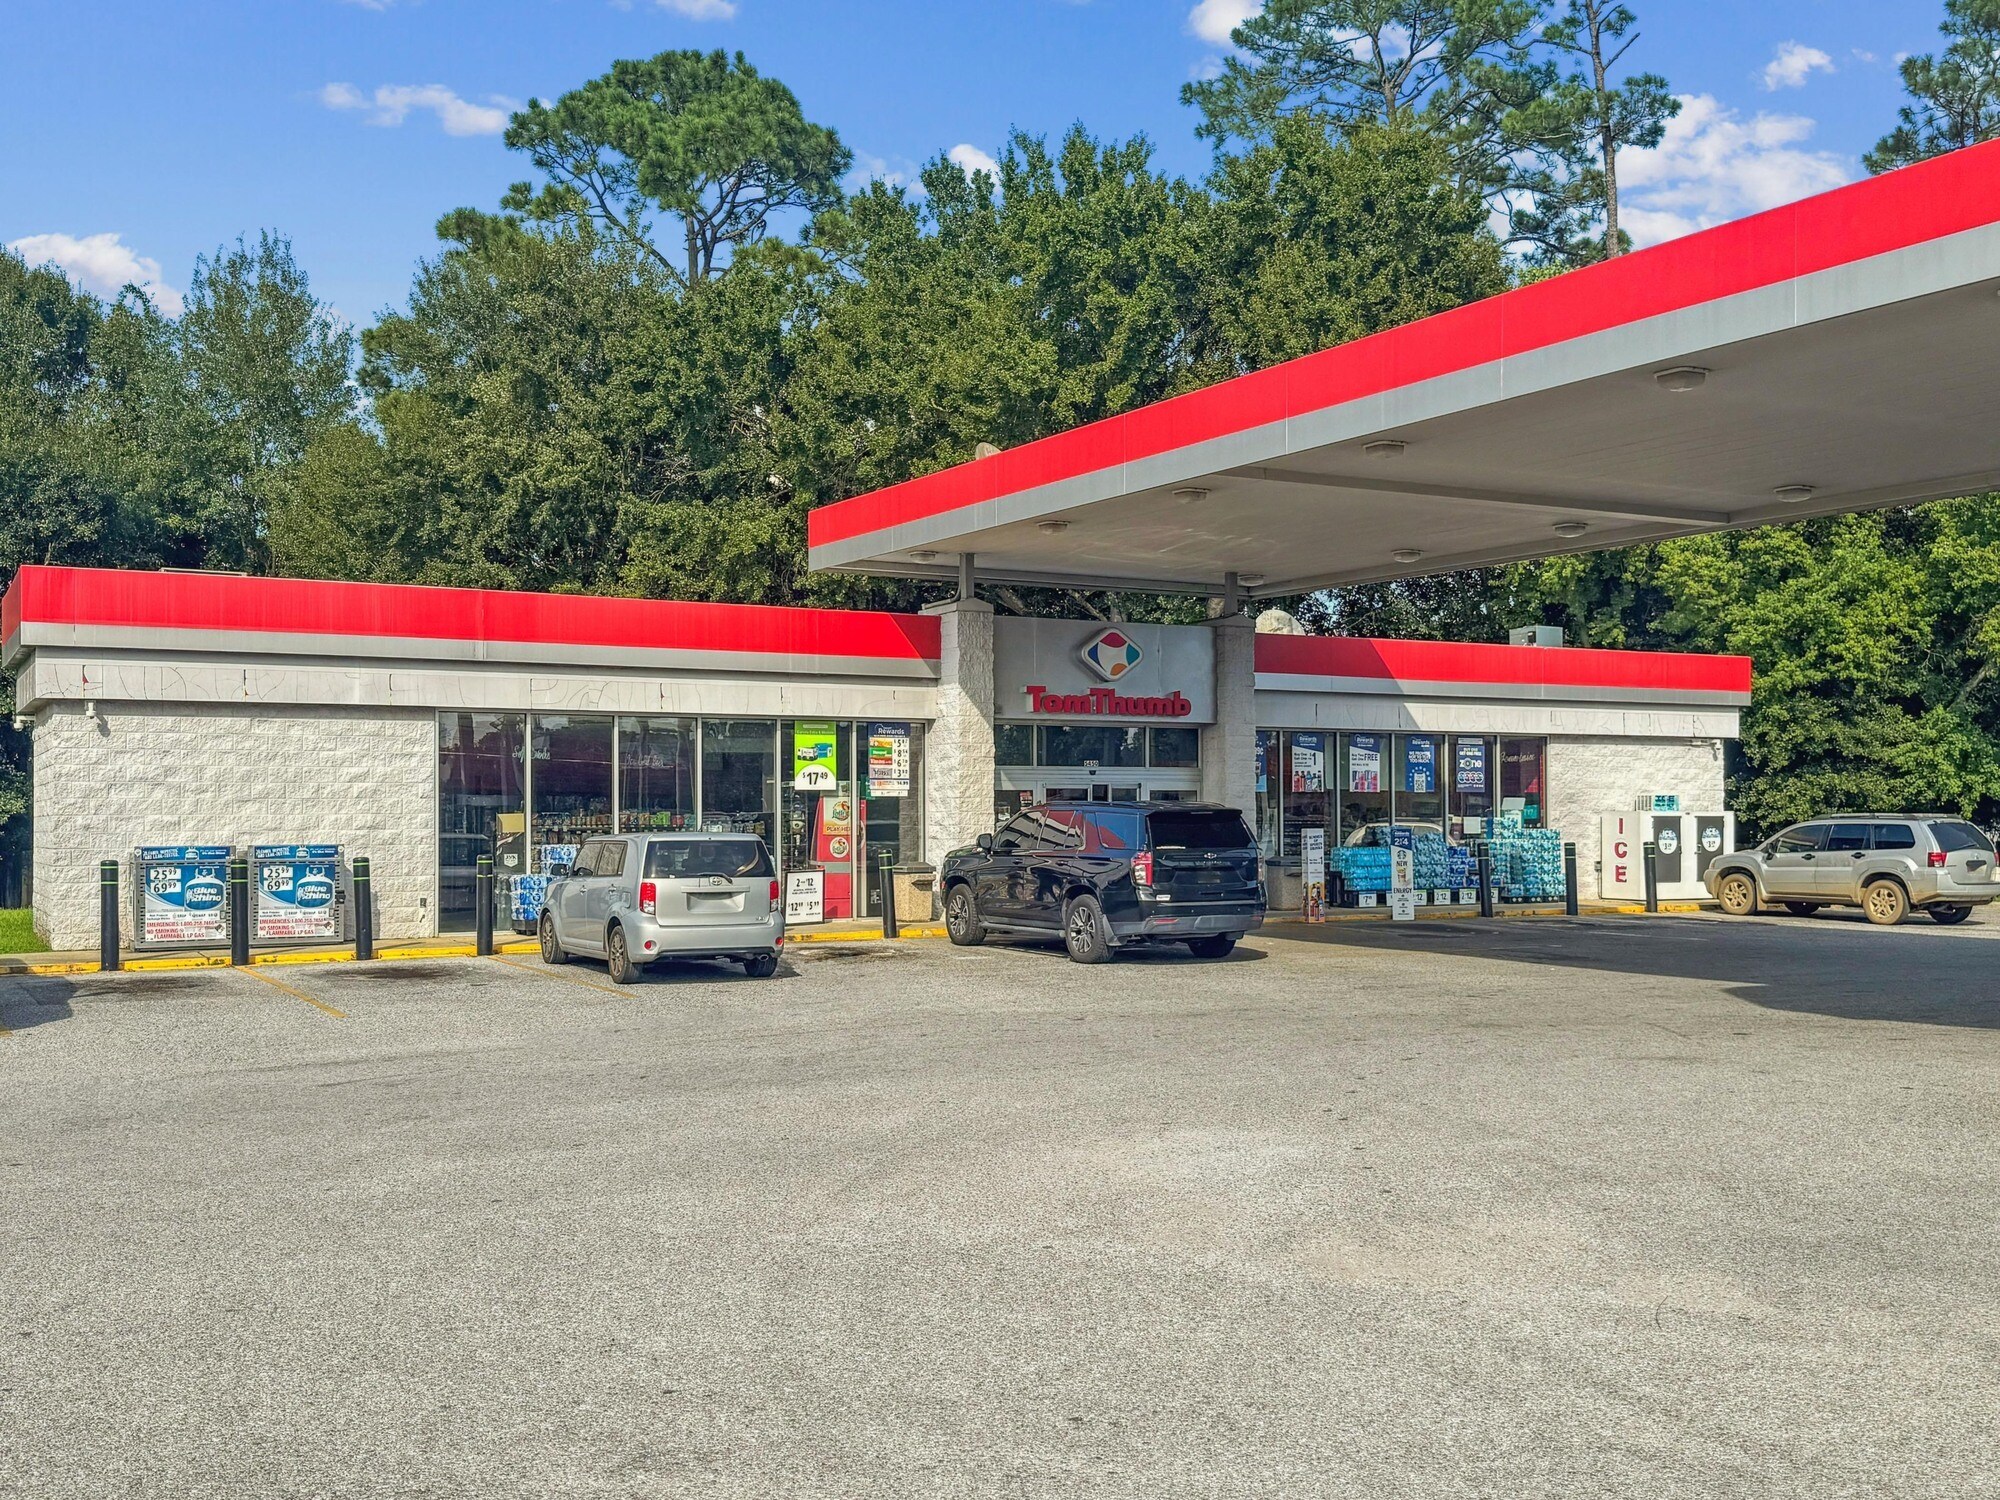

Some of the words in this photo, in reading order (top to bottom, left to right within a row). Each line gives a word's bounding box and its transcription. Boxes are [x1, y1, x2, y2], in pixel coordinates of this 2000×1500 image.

[1025, 686, 1191, 716] TomThumb
[1614, 818, 1627, 883] ICE
[154, 869, 176, 880] 2599
[154, 883, 176, 892] 6999
